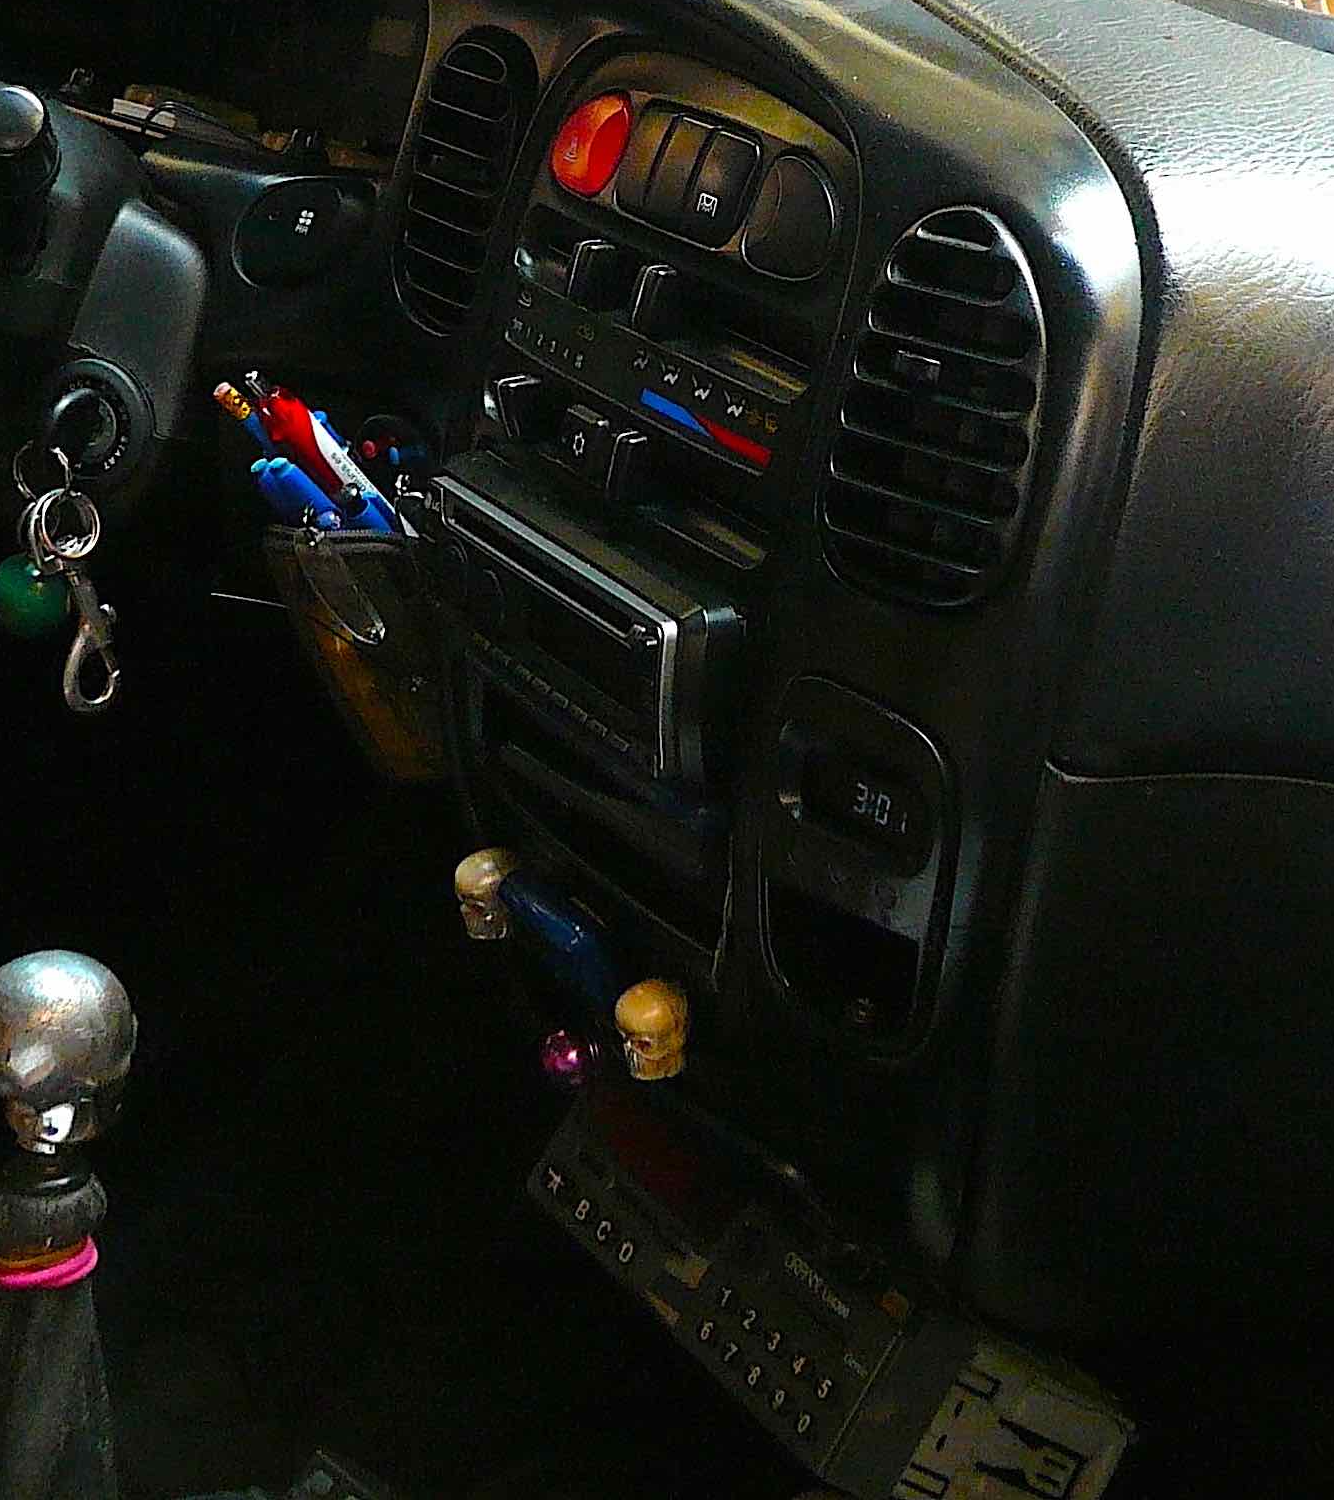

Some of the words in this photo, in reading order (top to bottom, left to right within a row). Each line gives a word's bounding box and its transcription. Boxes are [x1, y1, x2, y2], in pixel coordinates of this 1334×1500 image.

[575, 1198, 591, 1220] B
[596, 1219, 612, 1241] C
[699, 1320, 715, 1342] 6
[723, 1341, 739, 1364] 7
[747, 1365, 763, 1388] 8
[771, 1388, 787, 1412] 9
[720, 1286, 732, 1308] 1
[741, 1307, 758, 1331] 2
[767, 1330, 782, 1352] 3
[817, 1378, 834, 1400] 5
